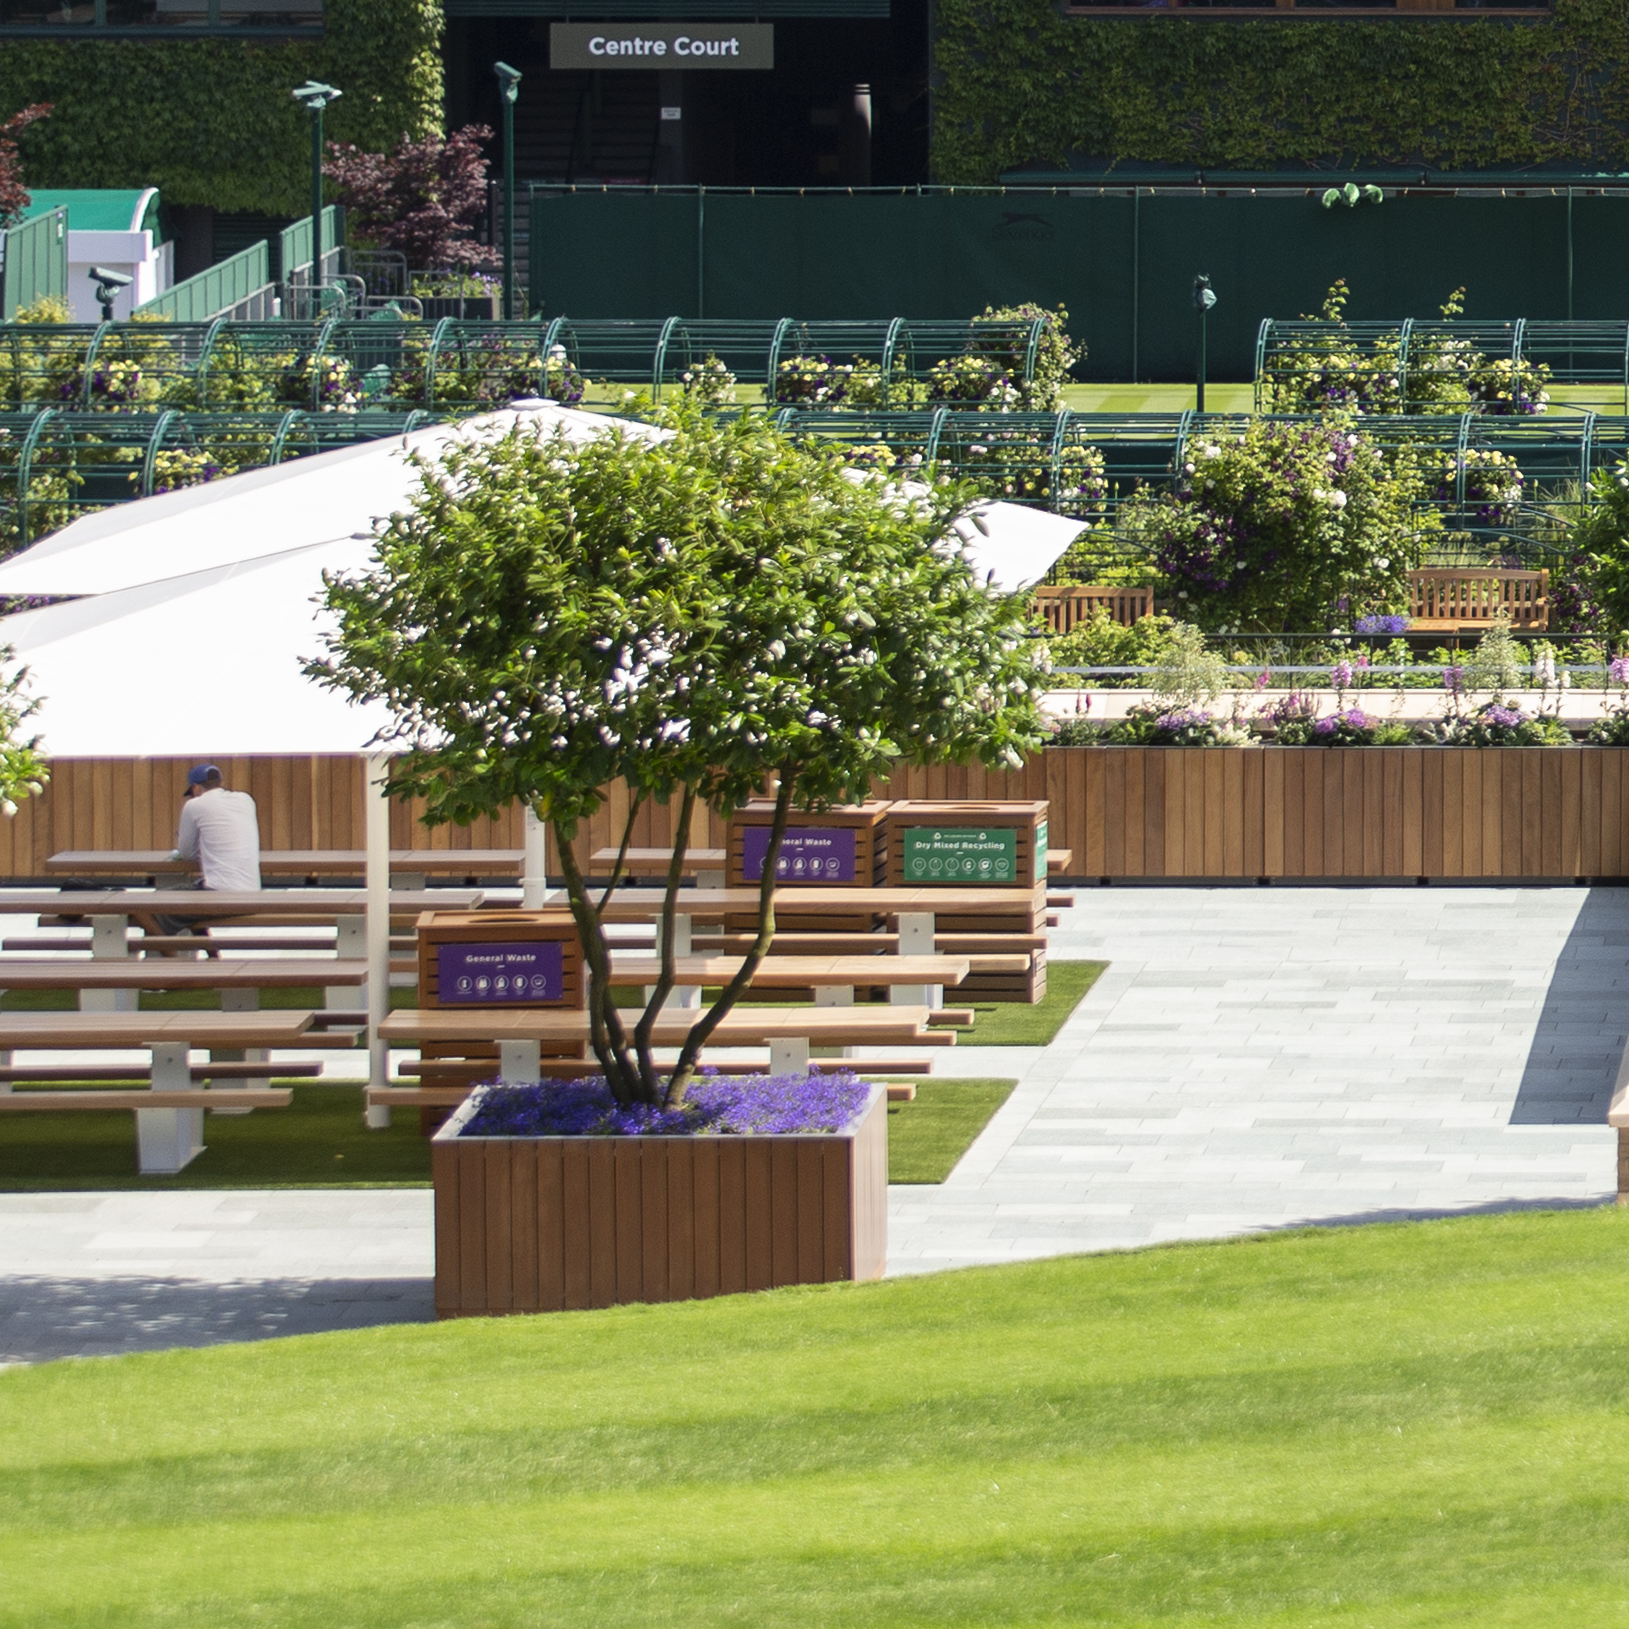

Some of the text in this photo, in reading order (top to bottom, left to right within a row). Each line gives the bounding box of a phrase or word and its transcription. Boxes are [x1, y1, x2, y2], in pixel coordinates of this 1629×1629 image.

[588, 36, 739, 56] Centre Court
[805, 837, 832, 846] Waste
[915, 841, 1005, 850] Dry Mixed Recycling
[465, 953, 537, 963] General Waste
